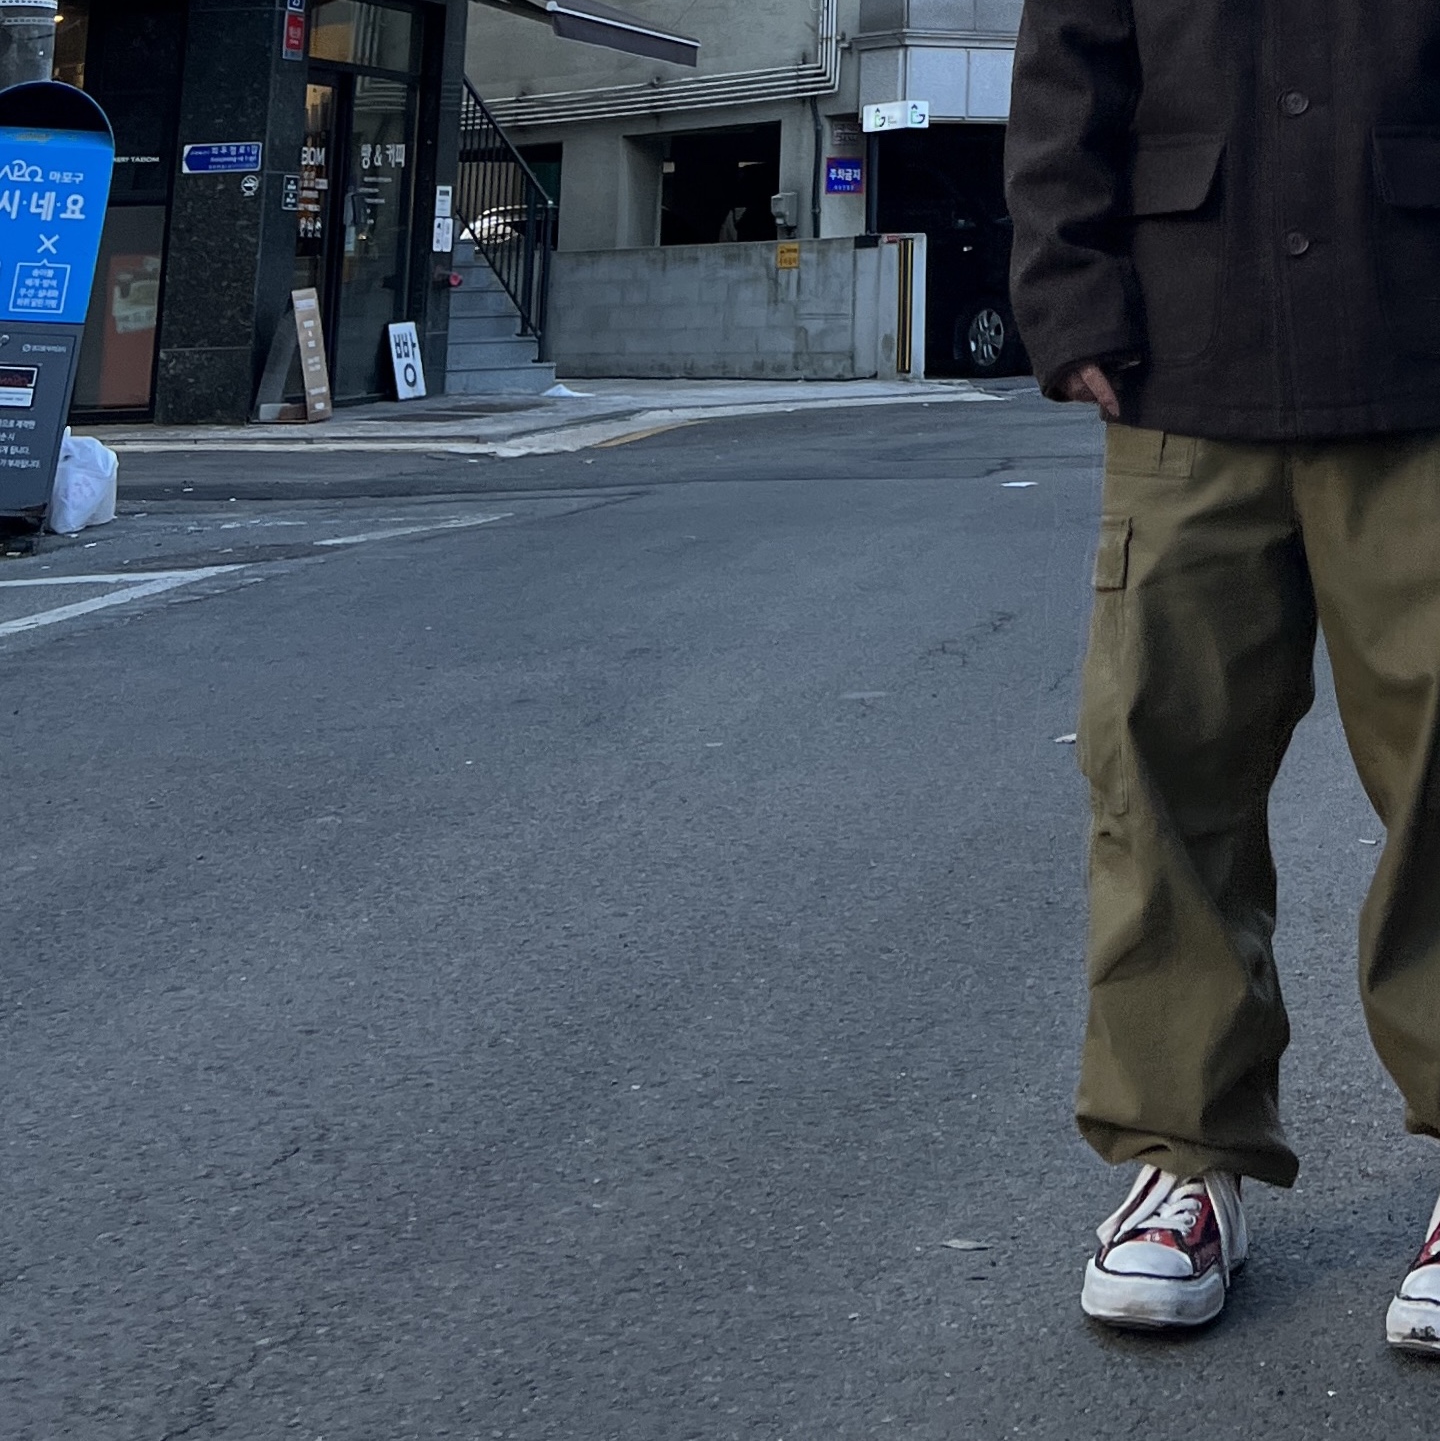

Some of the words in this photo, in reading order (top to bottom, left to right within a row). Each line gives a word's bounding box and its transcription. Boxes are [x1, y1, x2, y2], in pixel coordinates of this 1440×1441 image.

[385, 144, 406, 168] 커피
[49, 171, 84, 184] 마포구
[393, 331, 417, 387] 빵
